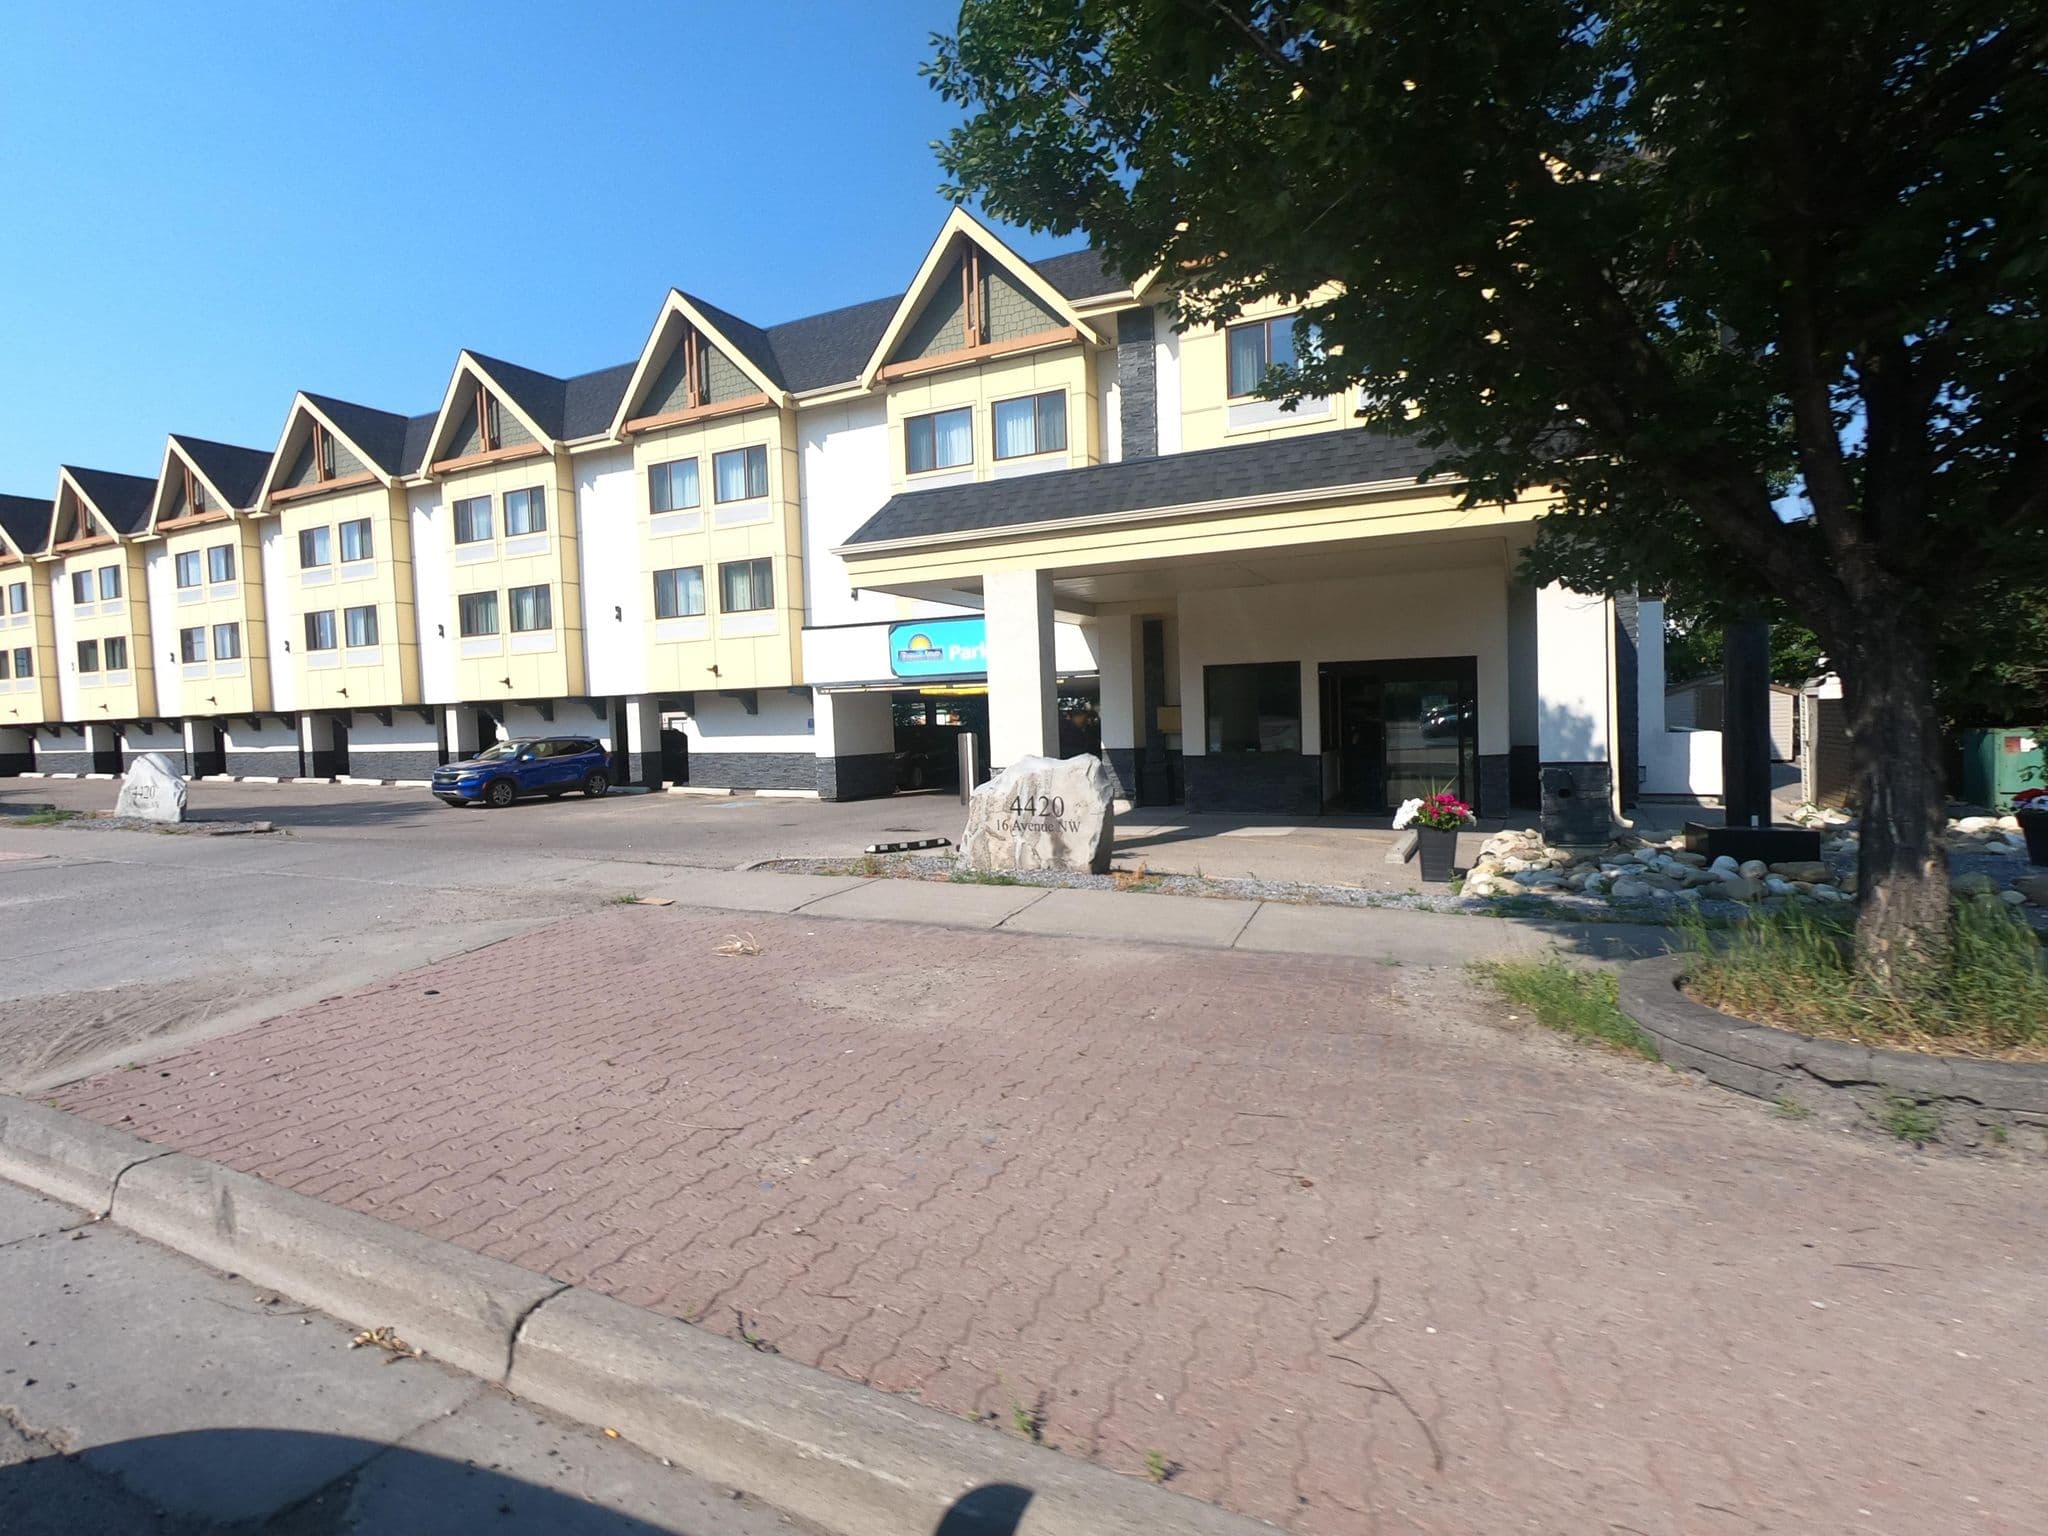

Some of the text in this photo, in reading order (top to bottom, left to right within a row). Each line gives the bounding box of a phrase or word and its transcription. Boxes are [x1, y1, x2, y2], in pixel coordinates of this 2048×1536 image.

[1010, 795, 1065, 817] 4420
[997, 819, 1080, 833] 16 Avenue NW
